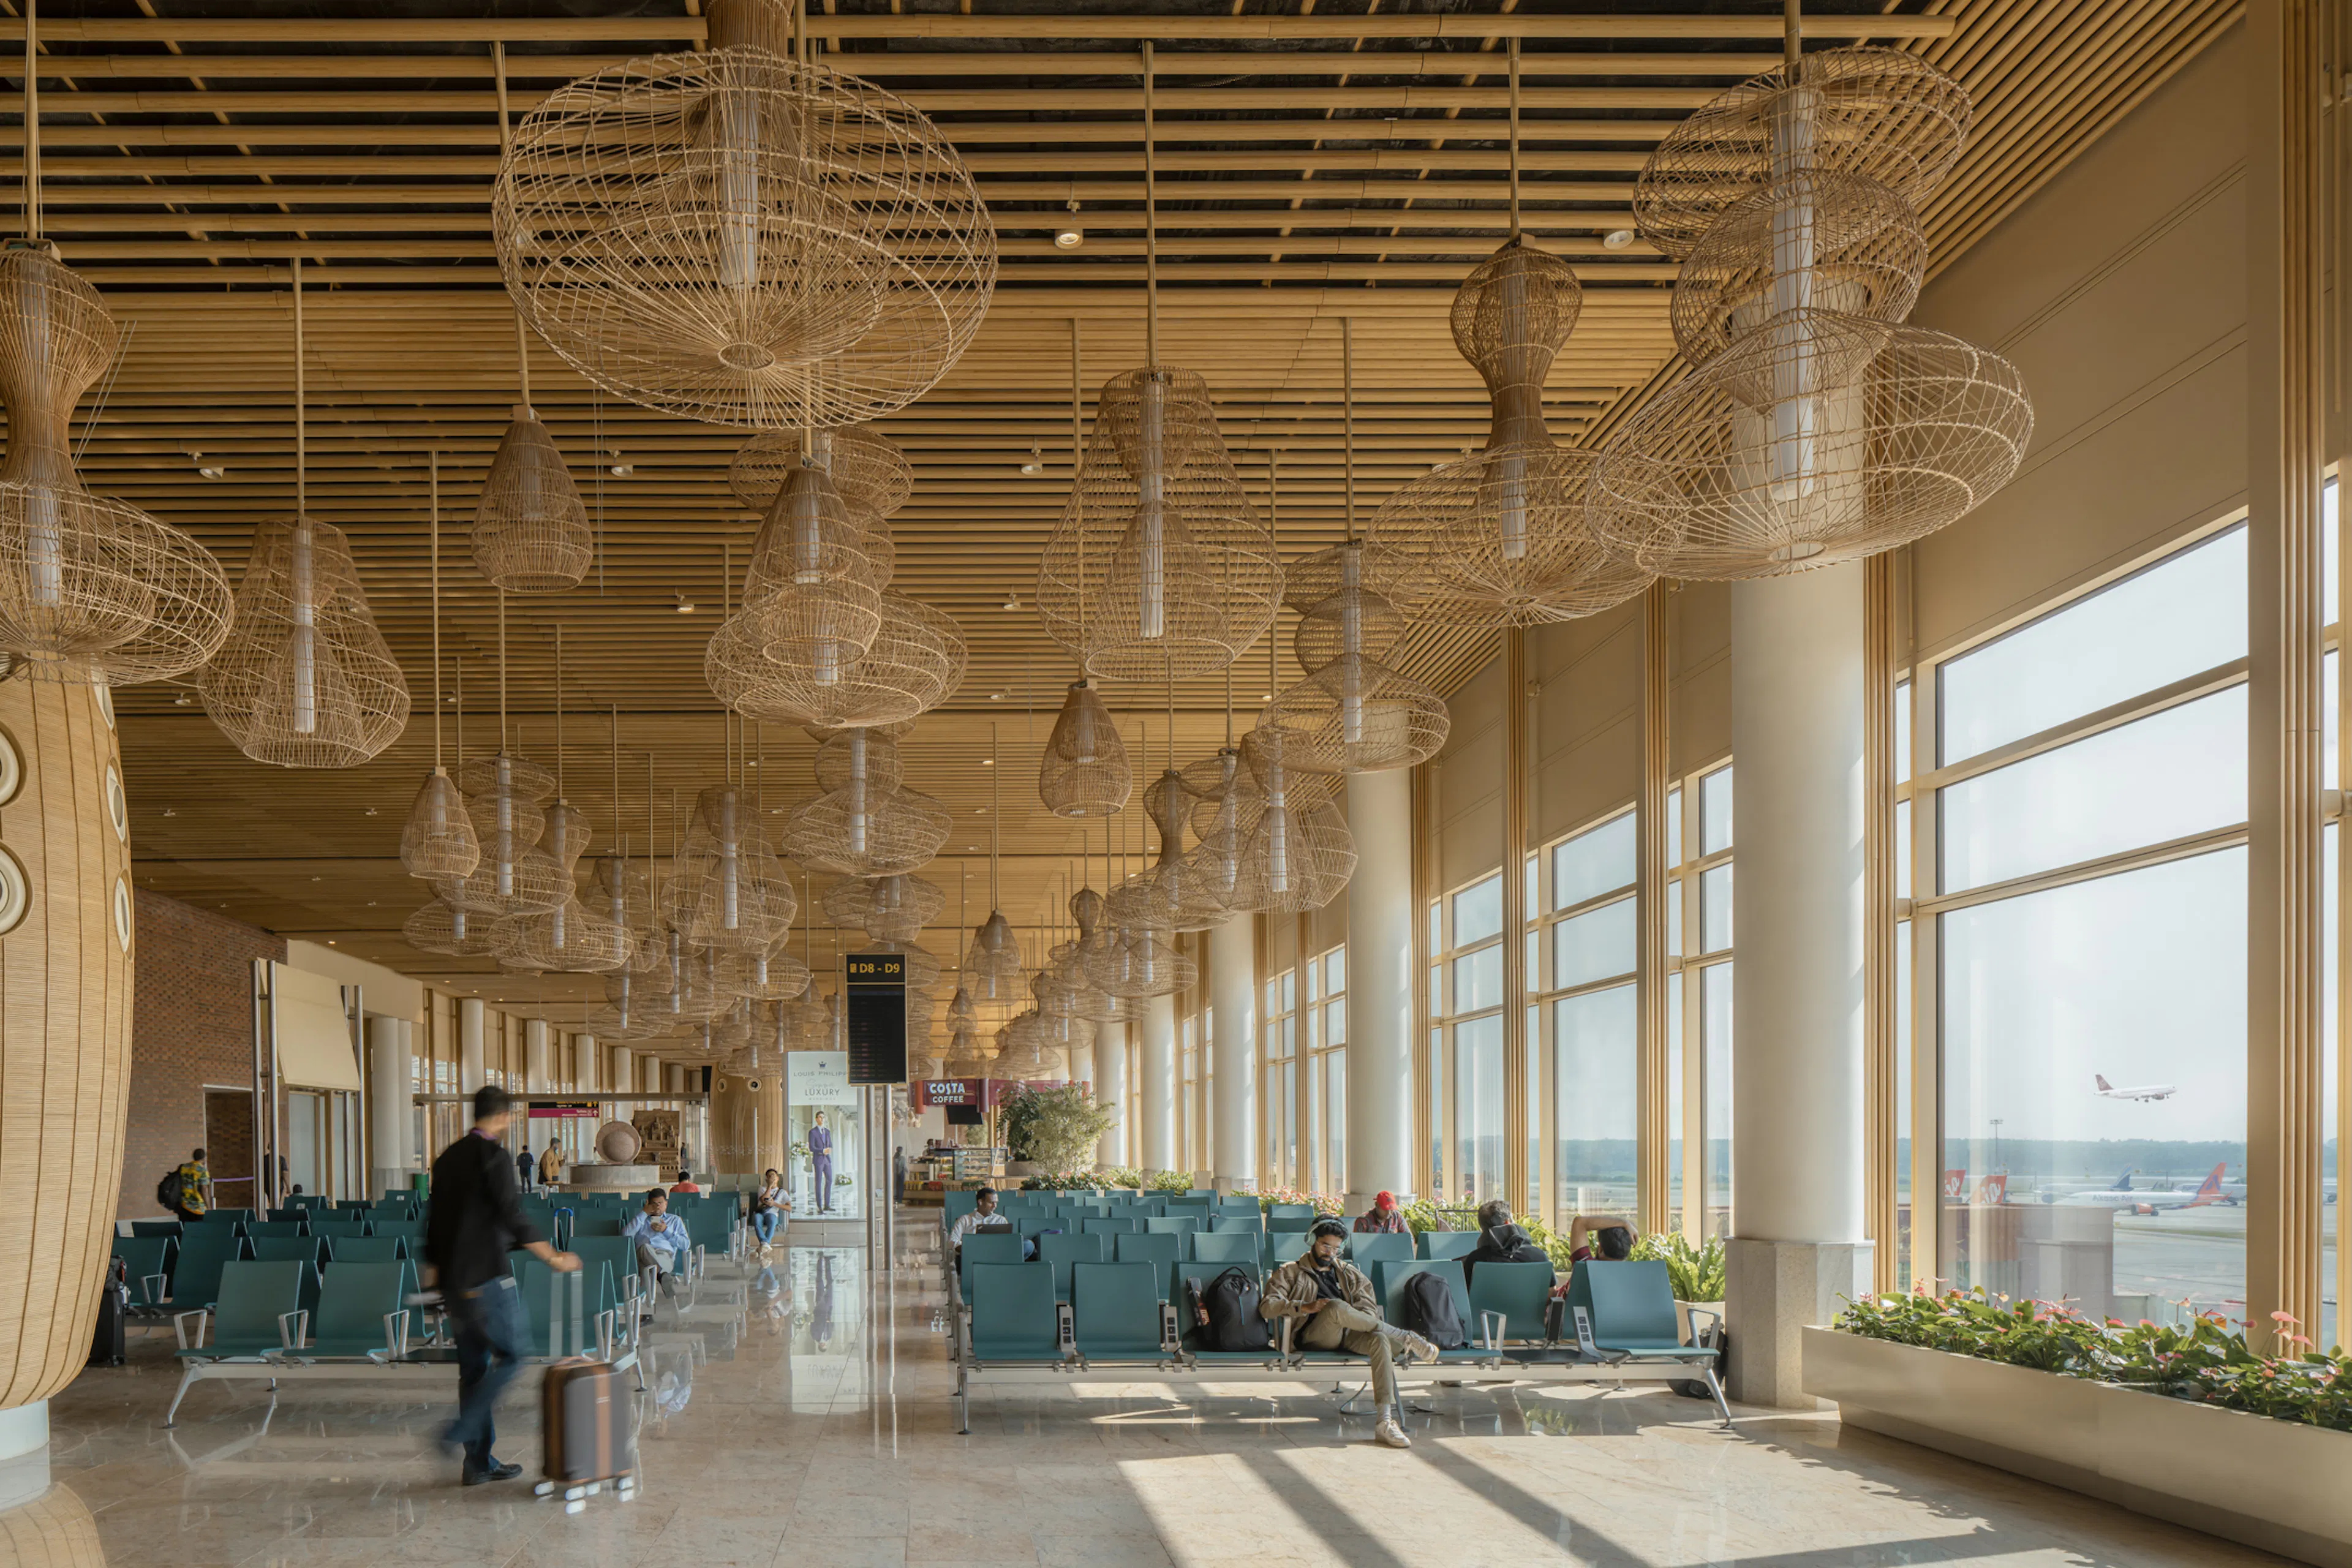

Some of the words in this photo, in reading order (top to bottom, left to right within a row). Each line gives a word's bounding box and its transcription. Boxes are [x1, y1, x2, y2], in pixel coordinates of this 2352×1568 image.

[859, 963, 875, 973] D8
[884, 963, 900, 973] D9
[929, 1082, 965, 1095] COSTA
